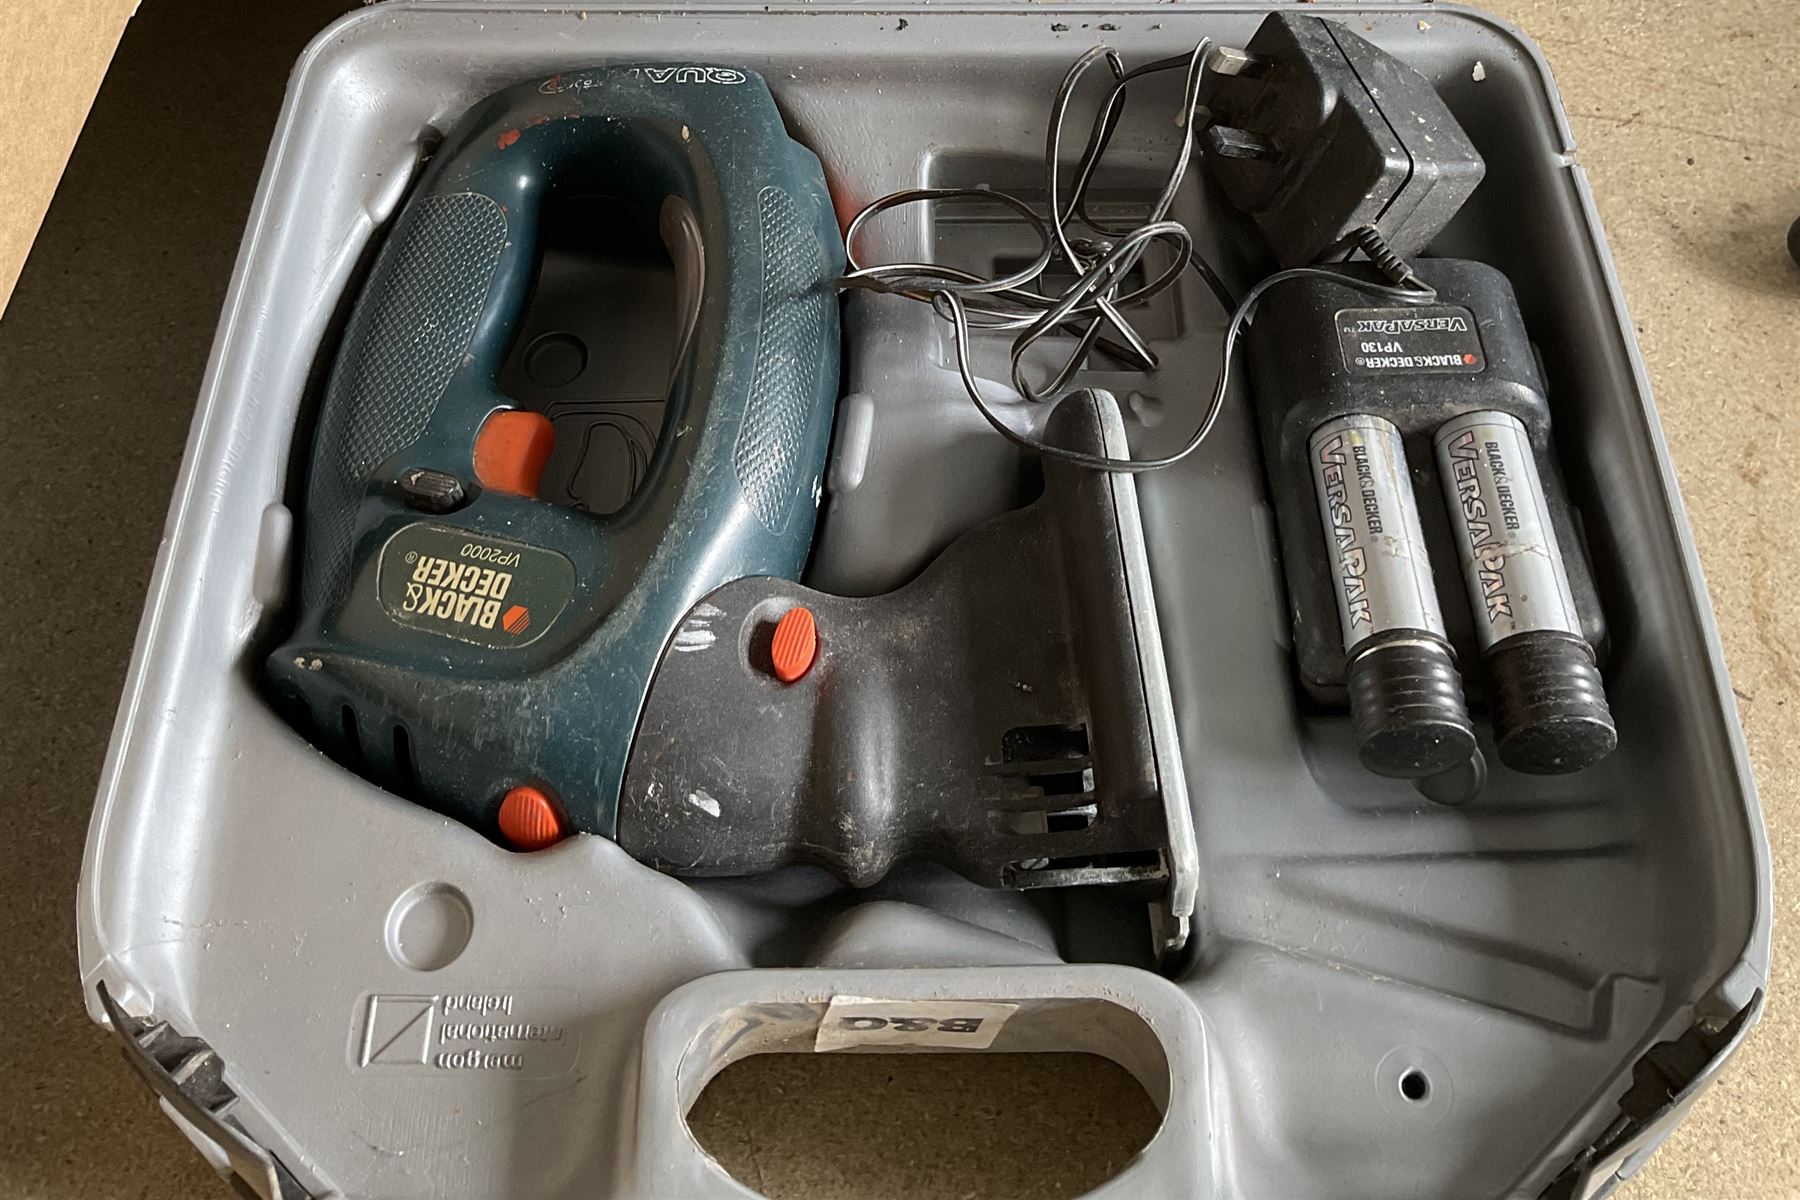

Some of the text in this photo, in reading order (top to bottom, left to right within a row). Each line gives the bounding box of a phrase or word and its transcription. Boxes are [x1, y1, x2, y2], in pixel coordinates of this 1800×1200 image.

[1357, 317, 1467, 334] VERSAPAK
[1361, 342, 1402, 353] VP130
[460, 543, 521, 568] VP2000
[412, 555, 513, 600] DECKER
[838, 1017, 984, 1034] B&Q
